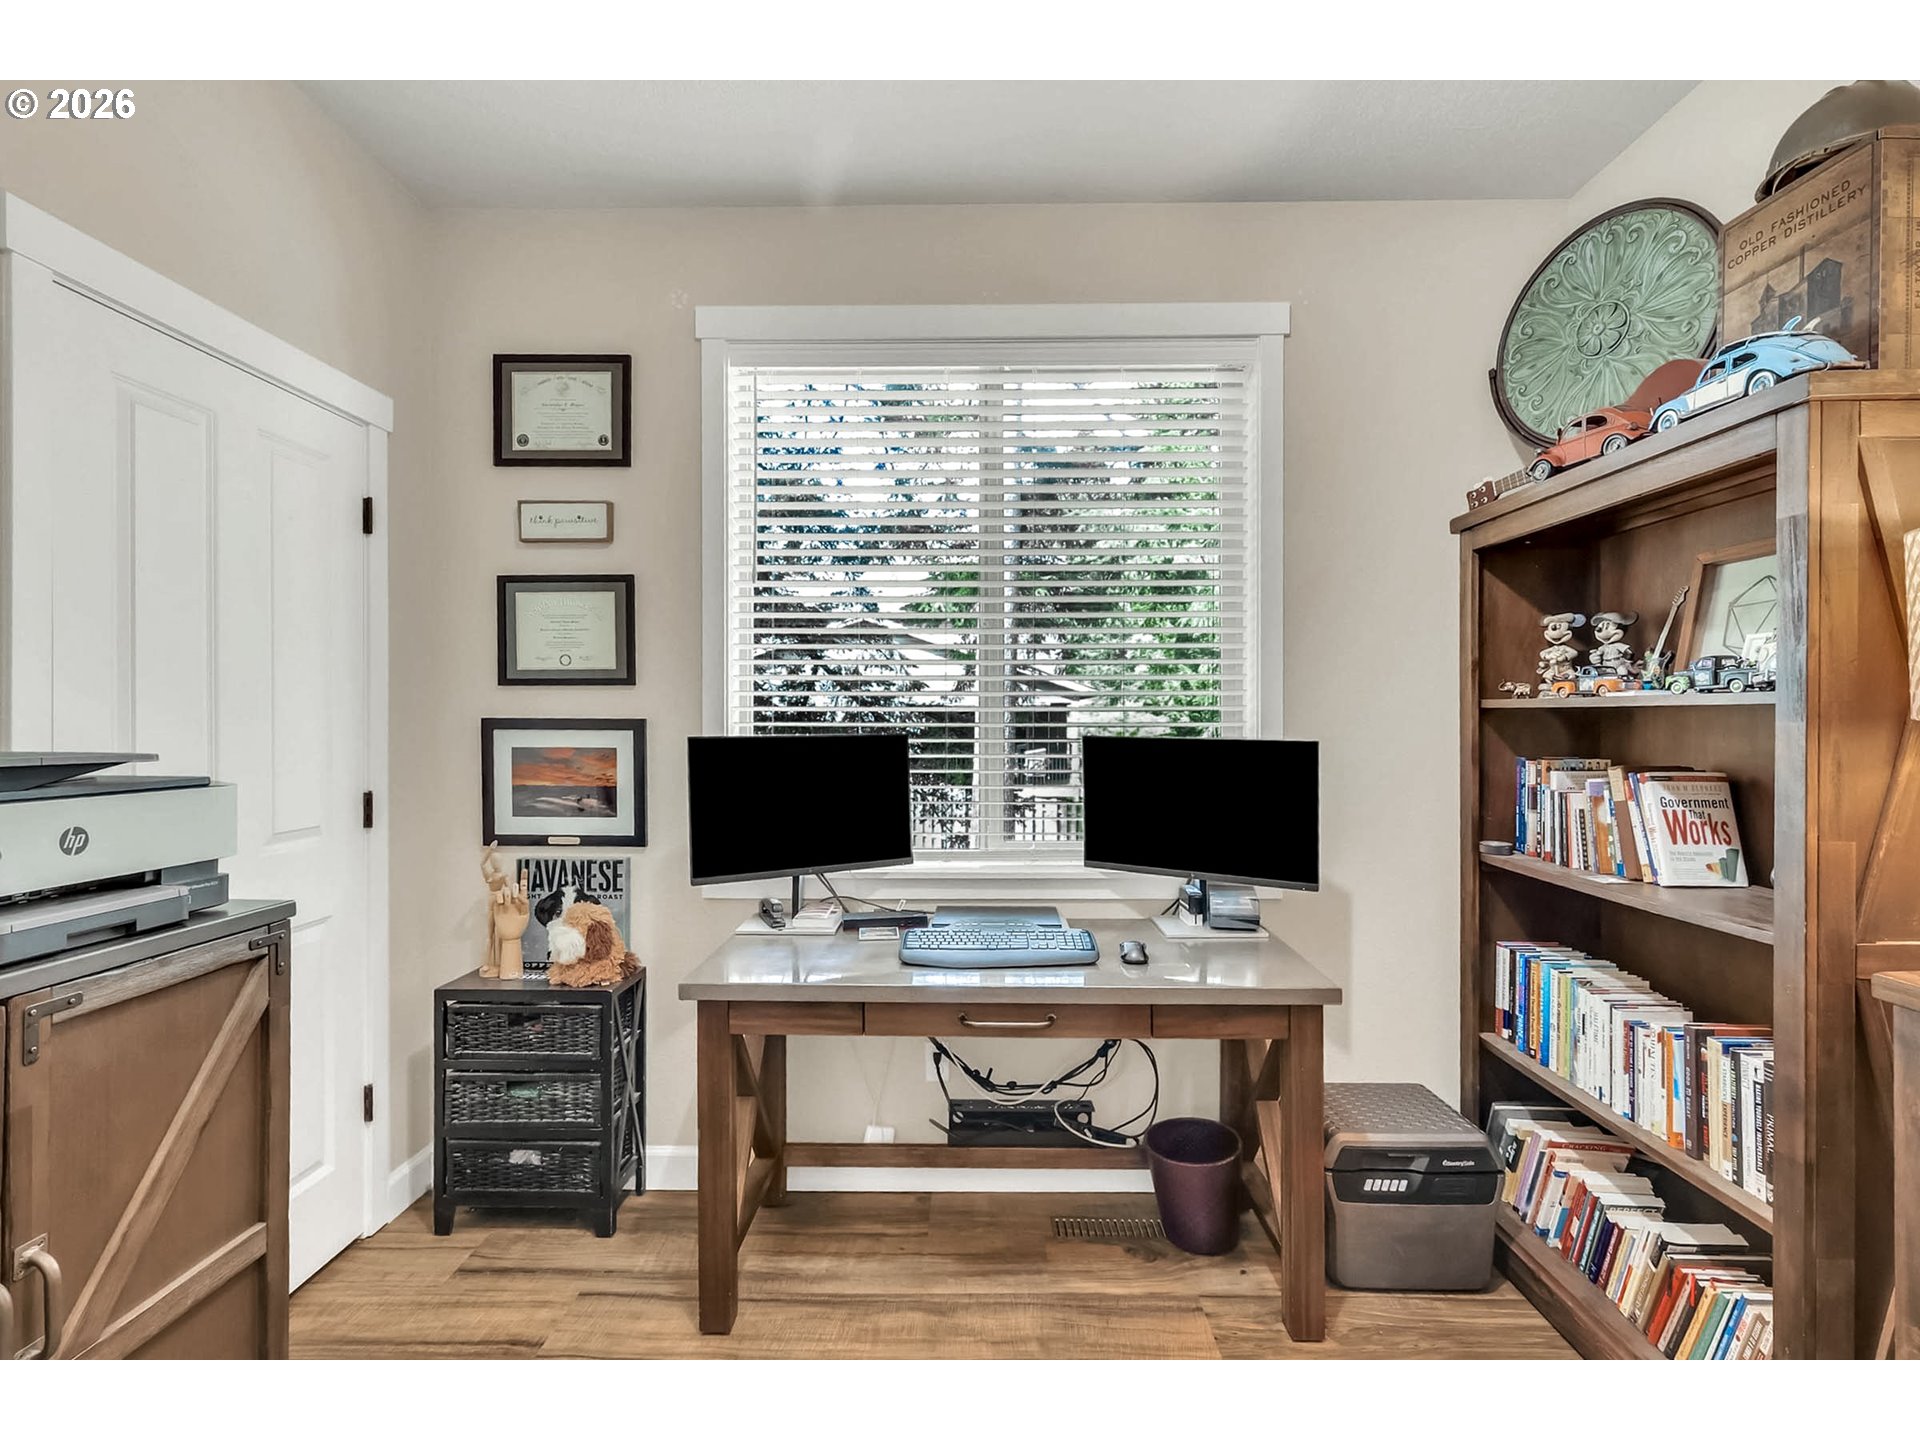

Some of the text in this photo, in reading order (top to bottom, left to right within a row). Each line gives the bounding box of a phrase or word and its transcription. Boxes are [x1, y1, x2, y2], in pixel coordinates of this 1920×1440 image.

[1727, 184, 1867, 270] COPPER DISTILLERY
[1739, 179, 1851, 250] OLD FASHIONED
[1660, 796, 1730, 809] Government
[1688, 809, 1706, 820] That
[63, 827, 86, 856] hp
[1661, 809, 1732, 846] Works
[516, 859, 624, 893] HAVANESE
[1685, 1087, 1692, 1096] TO
[1755, 1104, 1763, 1131] YOURSELF
[1561, 1143, 1607, 1152] CRACKING
[1766, 1113, 1775, 1154] PRIMAL
[1756, 1131, 1764, 1172] INDISPENSABLE
